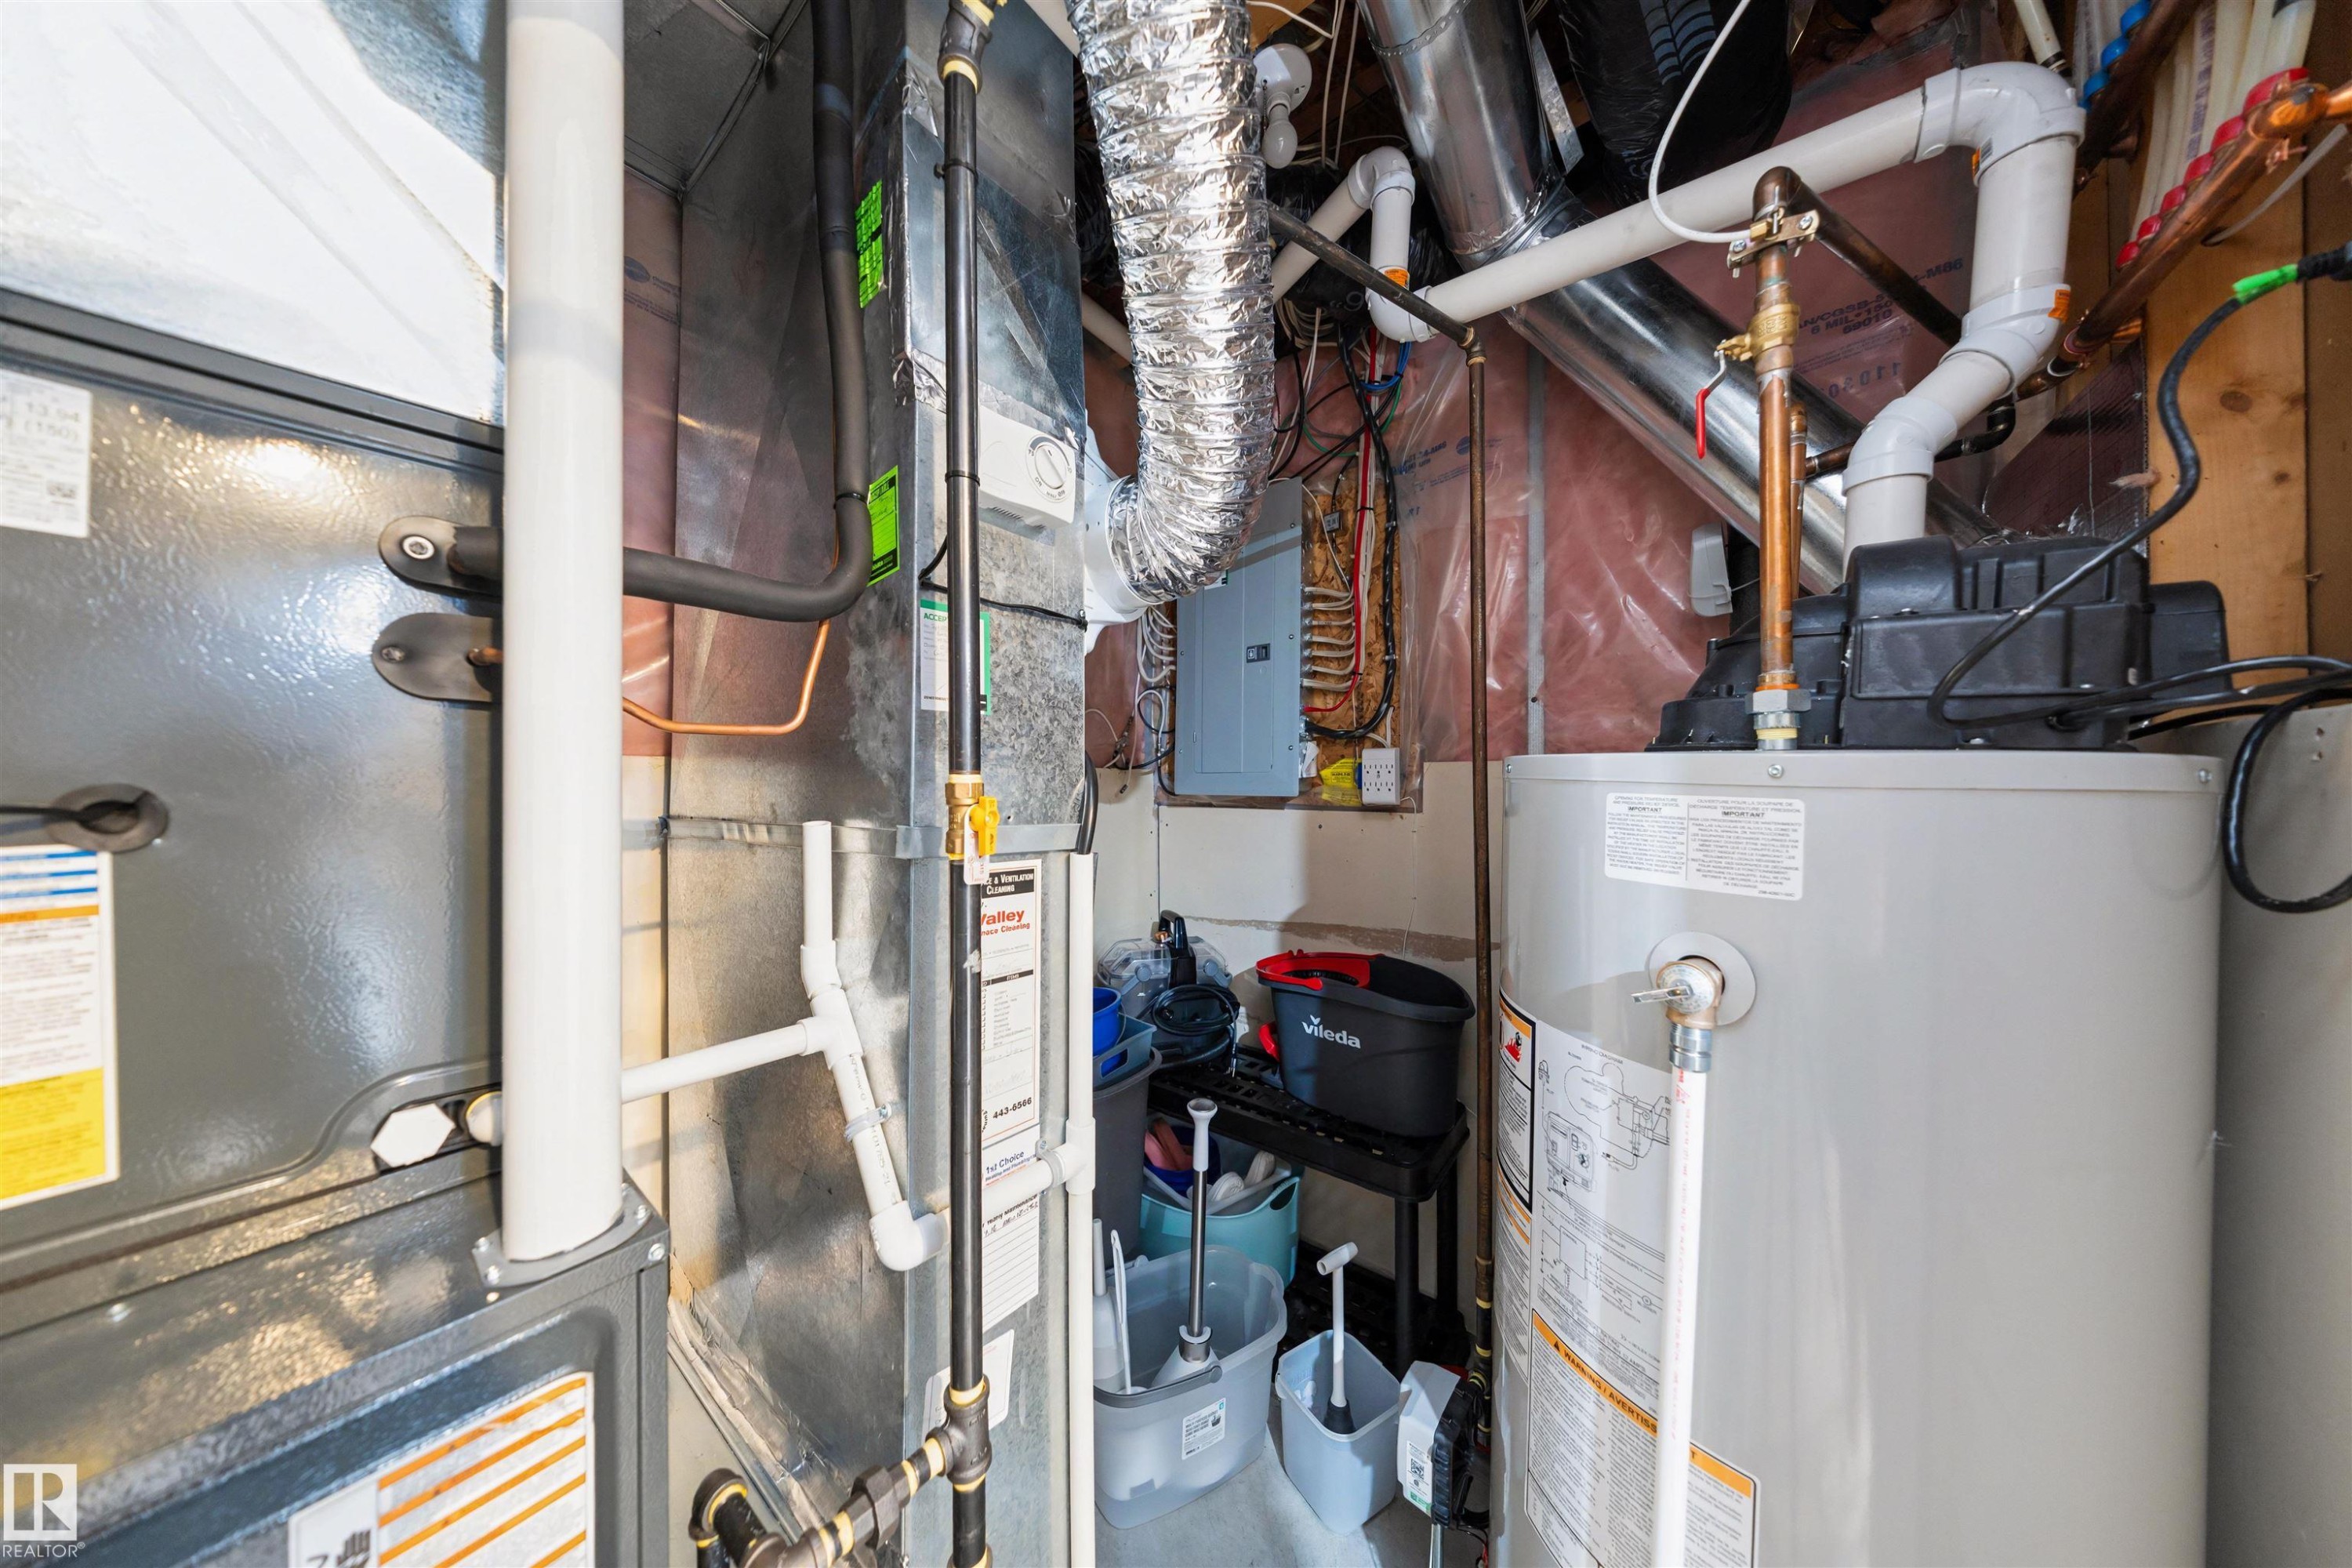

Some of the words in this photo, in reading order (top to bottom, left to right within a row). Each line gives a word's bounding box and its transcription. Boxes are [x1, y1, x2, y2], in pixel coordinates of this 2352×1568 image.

[1000, 873, 1034, 884] VENTILATION
[986, 884, 1015, 895] CLEANING
[1000, 923, 1031, 933] Cleaning
[1301, 1014, 1362, 1049] vileda
[993, 1097, 1033, 1119] 443-6566
[999, 1151, 1025, 1167] Choice
[1564, 1349, 1602, 1390] WARNING
